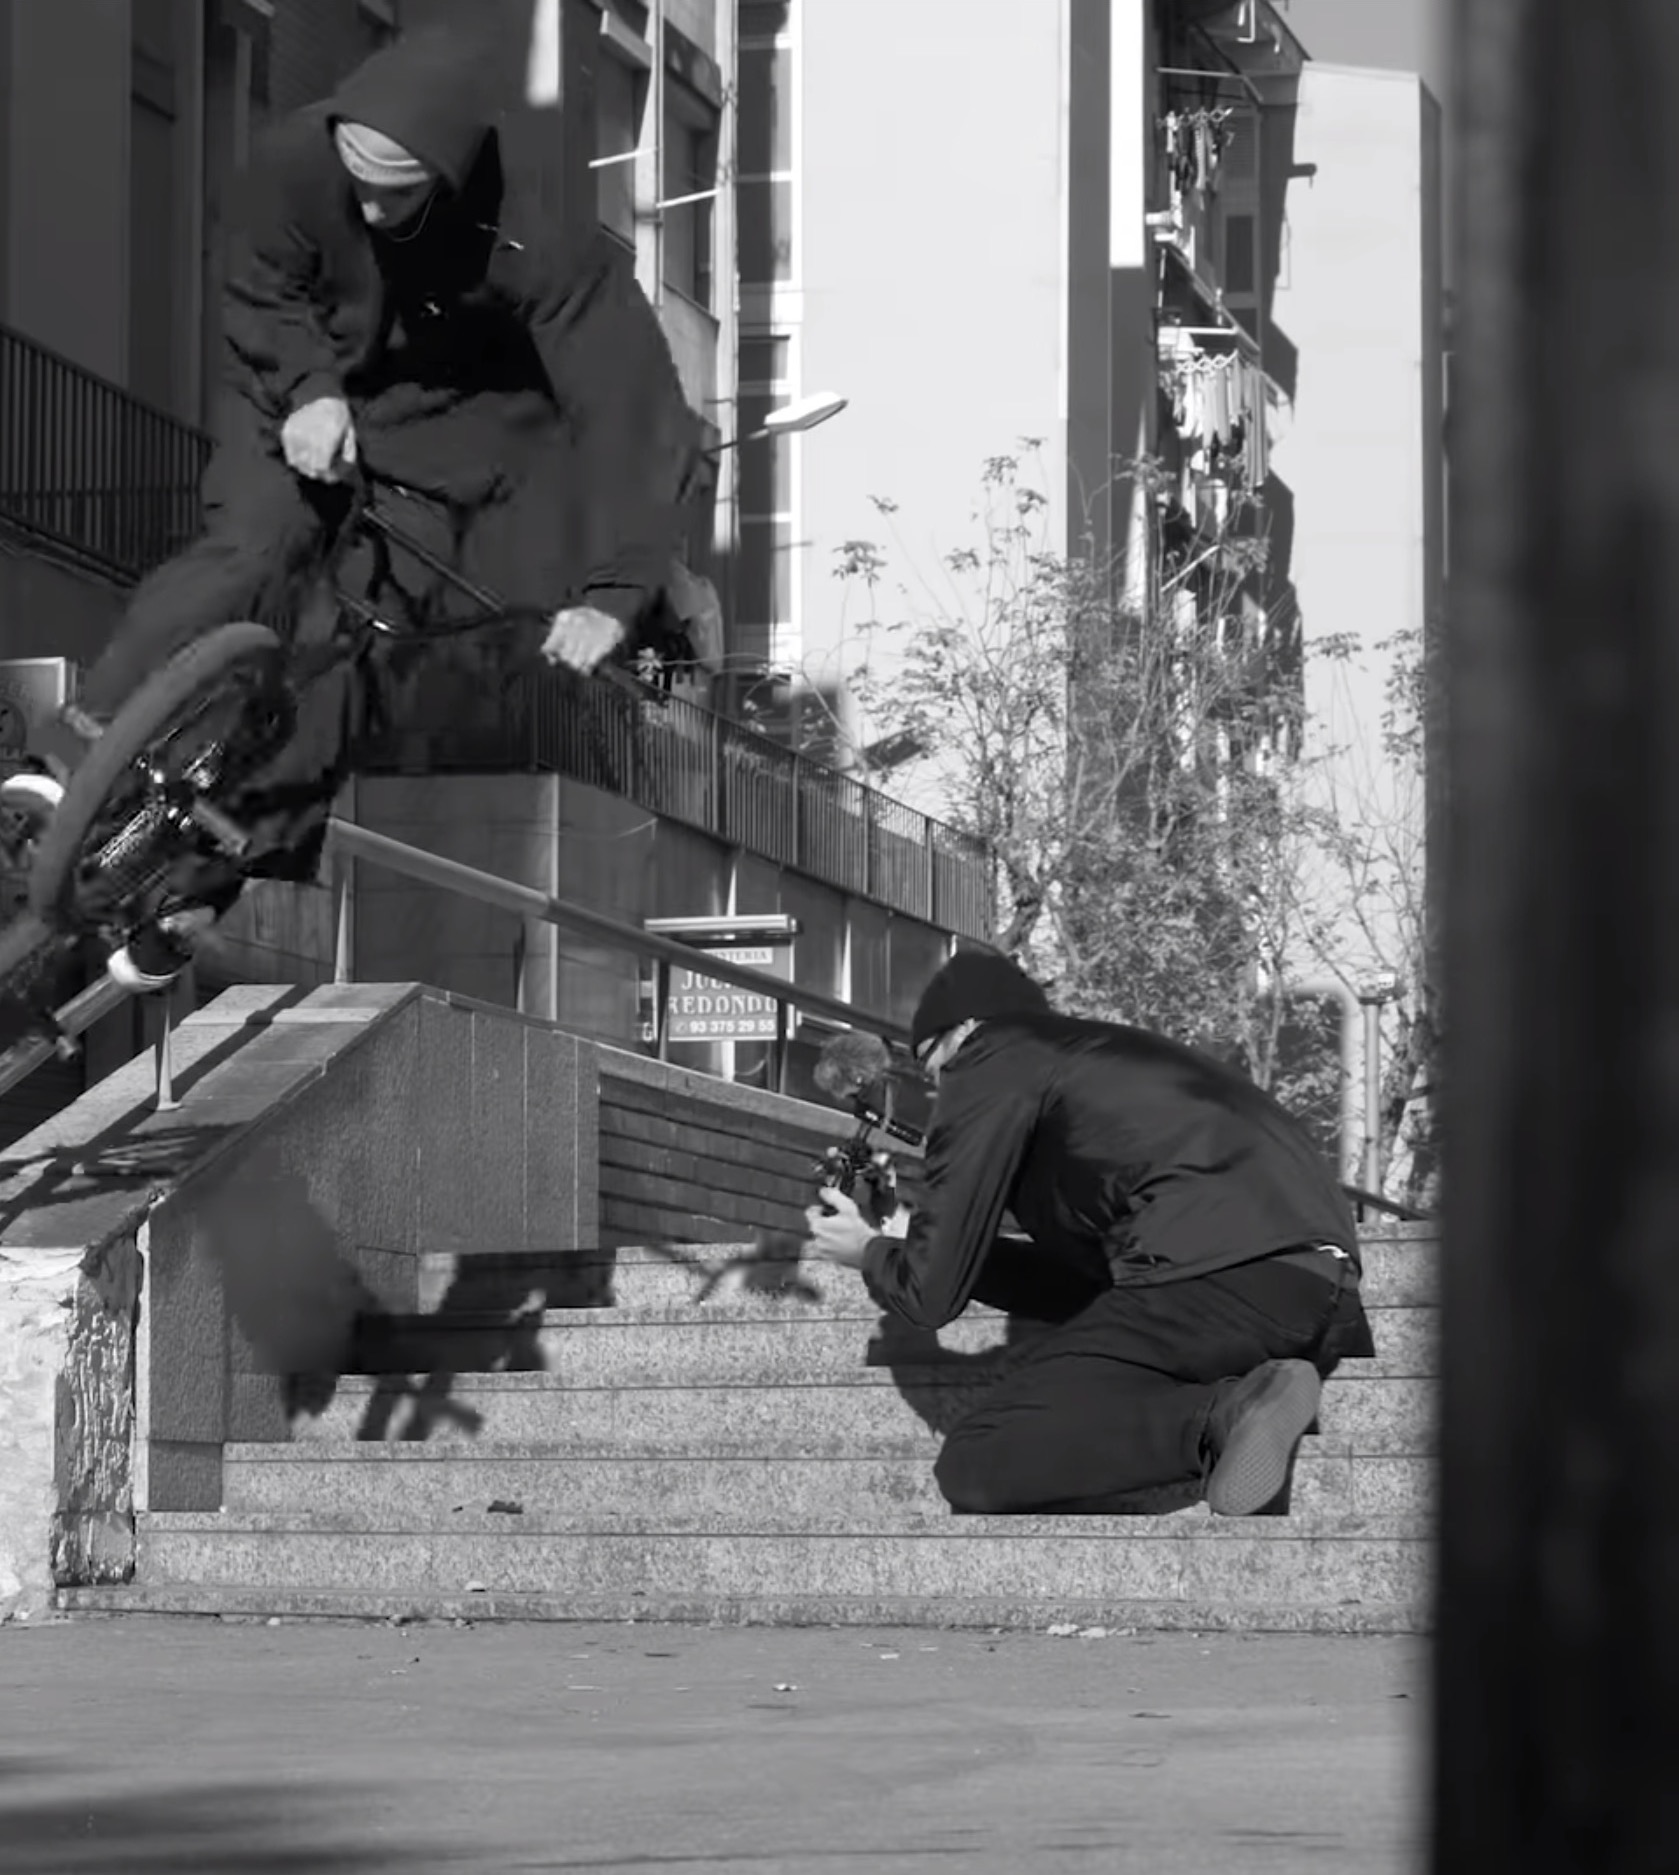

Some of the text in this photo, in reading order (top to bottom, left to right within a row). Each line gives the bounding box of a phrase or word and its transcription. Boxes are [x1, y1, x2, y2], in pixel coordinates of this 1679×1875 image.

[689, 1019, 776, 1033] 93 375 29 55
